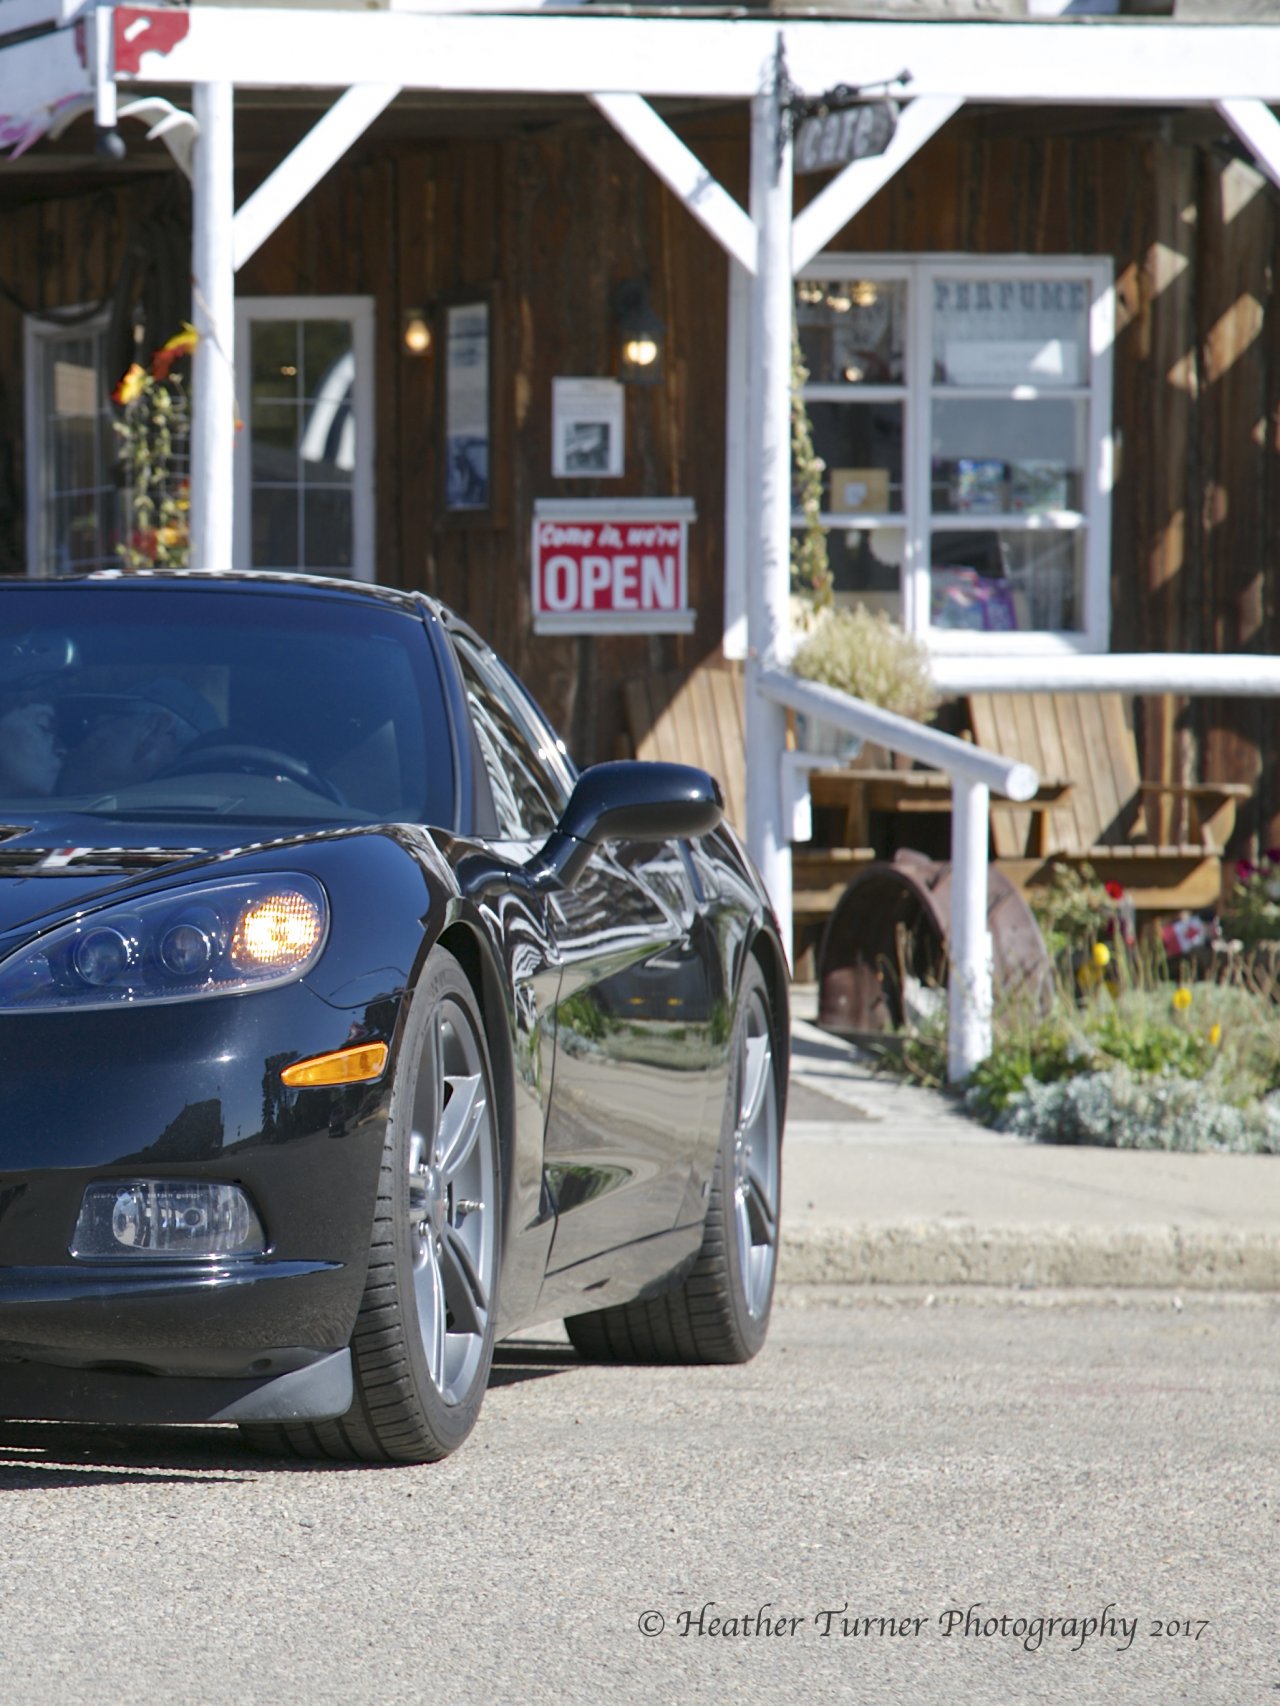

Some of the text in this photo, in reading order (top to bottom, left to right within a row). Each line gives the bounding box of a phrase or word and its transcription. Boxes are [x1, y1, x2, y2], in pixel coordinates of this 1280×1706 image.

[541, 524, 594, 548] Come
[627, 525, 679, 547] we're
[544, 554, 675, 611] OPEN
